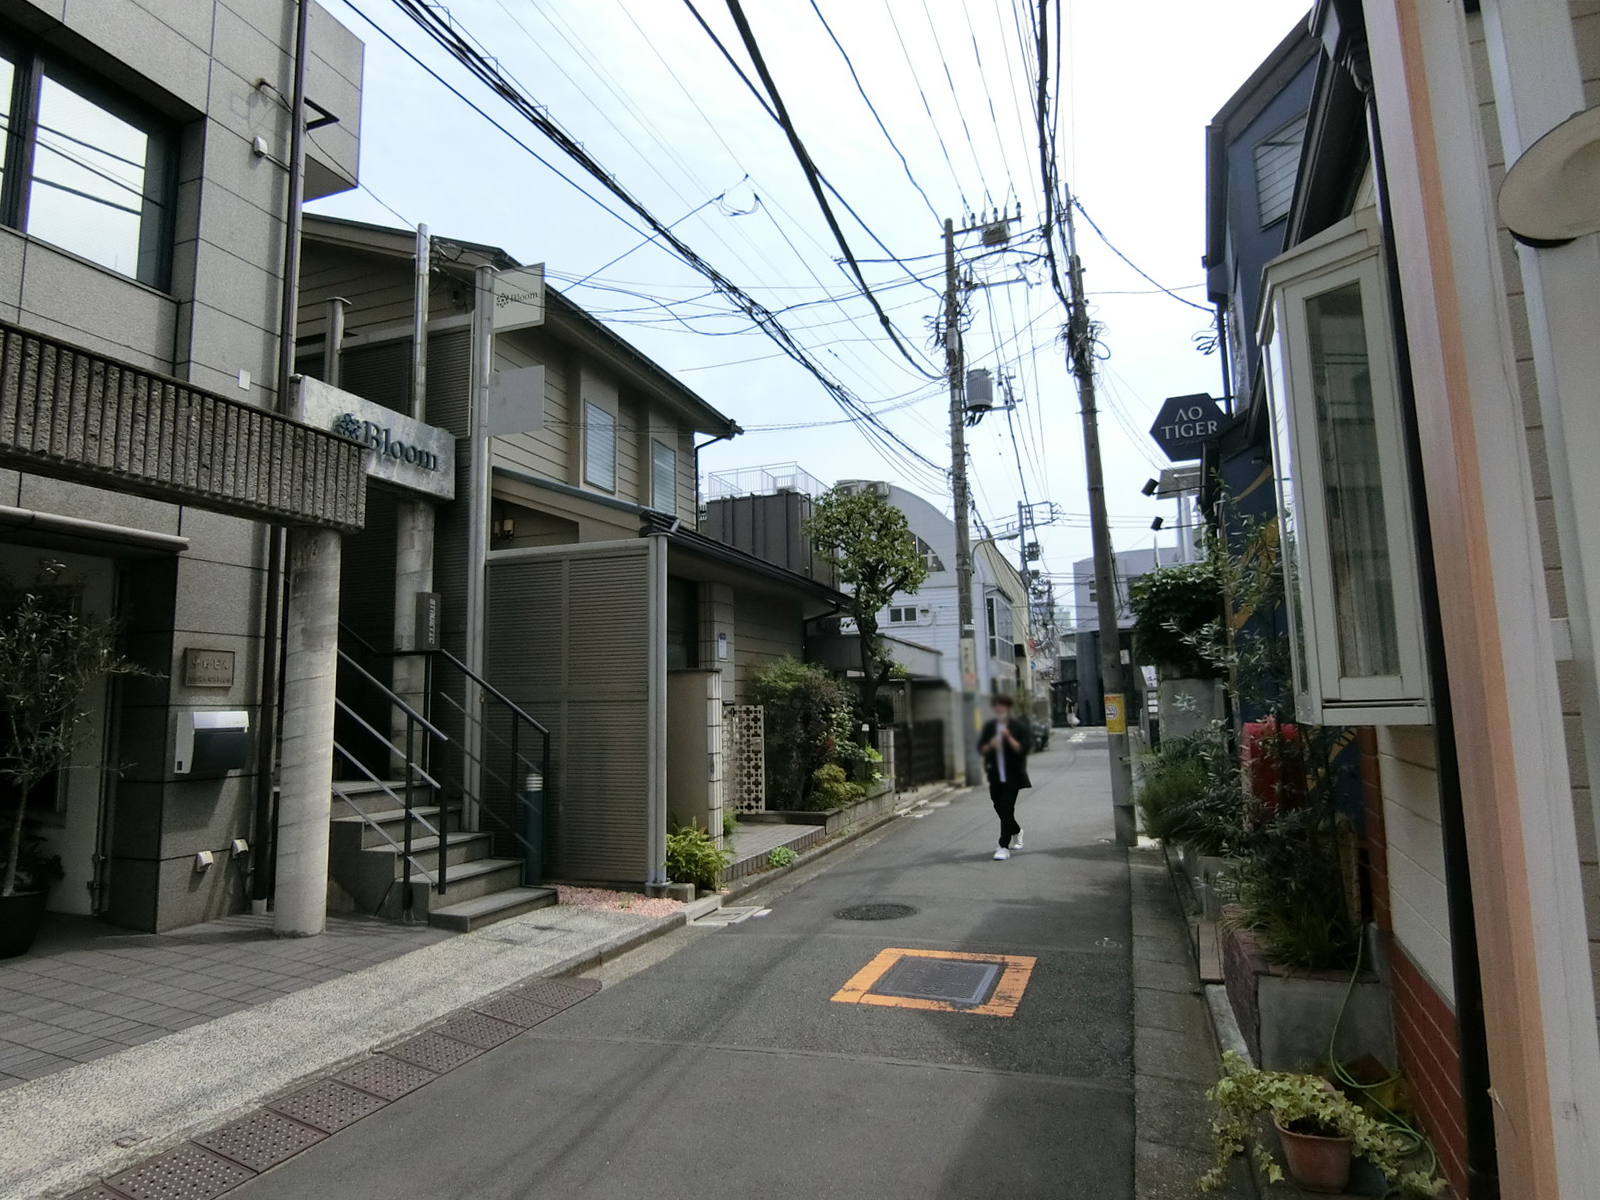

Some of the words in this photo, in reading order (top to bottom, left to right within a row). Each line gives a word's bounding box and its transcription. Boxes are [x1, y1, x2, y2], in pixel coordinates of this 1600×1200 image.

[510, 292, 538, 301] Bloom
[1175, 406, 1203, 422] AO
[1160, 420, 1217, 440] TIGER
[363, 421, 440, 472] Bloom
